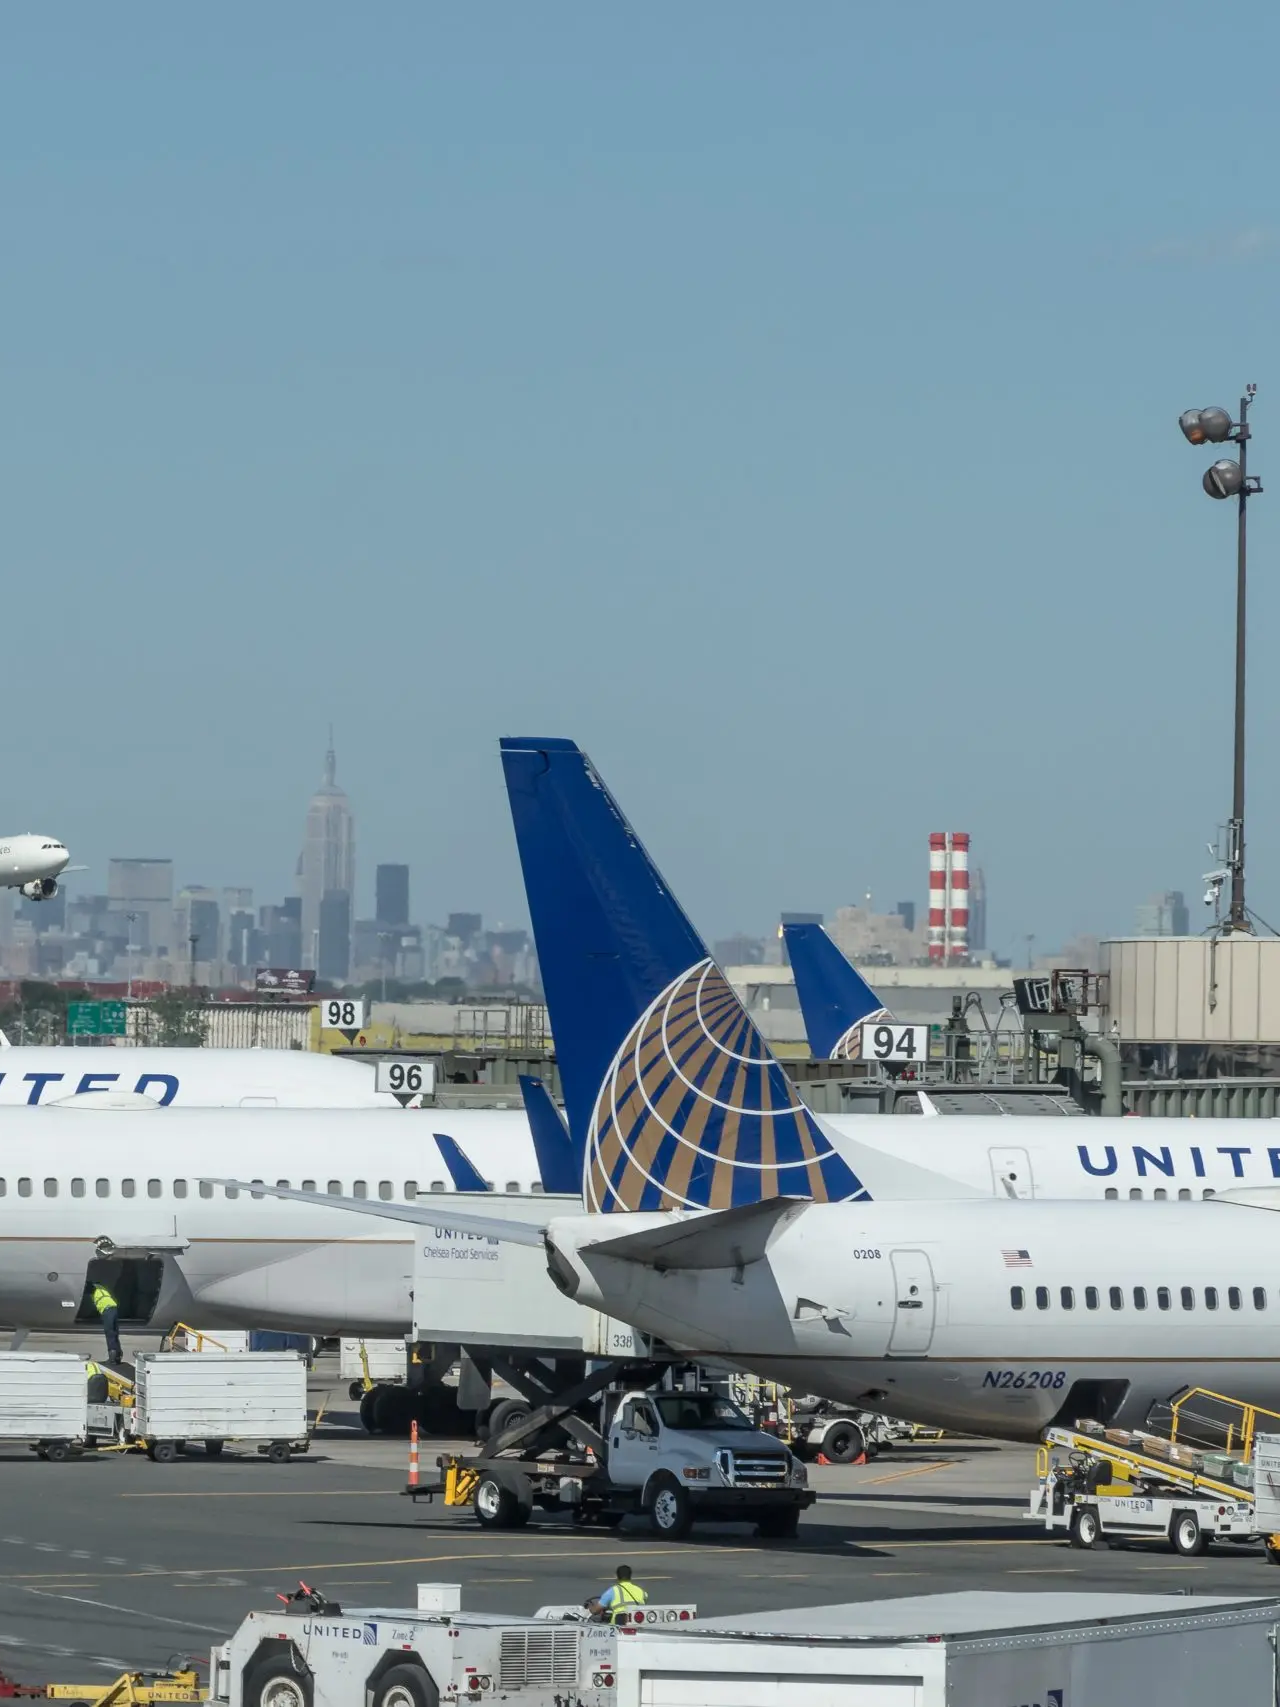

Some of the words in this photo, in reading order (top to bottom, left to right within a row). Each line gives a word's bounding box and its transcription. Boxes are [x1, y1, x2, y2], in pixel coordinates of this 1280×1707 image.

[328, 1001, 355, 1026] 98
[873, 1026, 917, 1059] 94
[389, 1064, 422, 1090] 96
[423, 1246, 450, 1259] Chelsea
[451, 1247, 469, 1260] Food
[470, 1248, 499, 1261] Services
[853, 1249, 882, 1259] 0208
[613, 1334, 633, 1348] 338
[982, 1370, 1066, 1390] N26208
[1115, 1499, 1146, 1509] UNITED
[303, 1624, 361, 1639] UNITED
[587, 1628, 607, 1638] Zone
[609, 1628, 615, 1638] 2
[148, 1691, 189, 1700] UNITED
